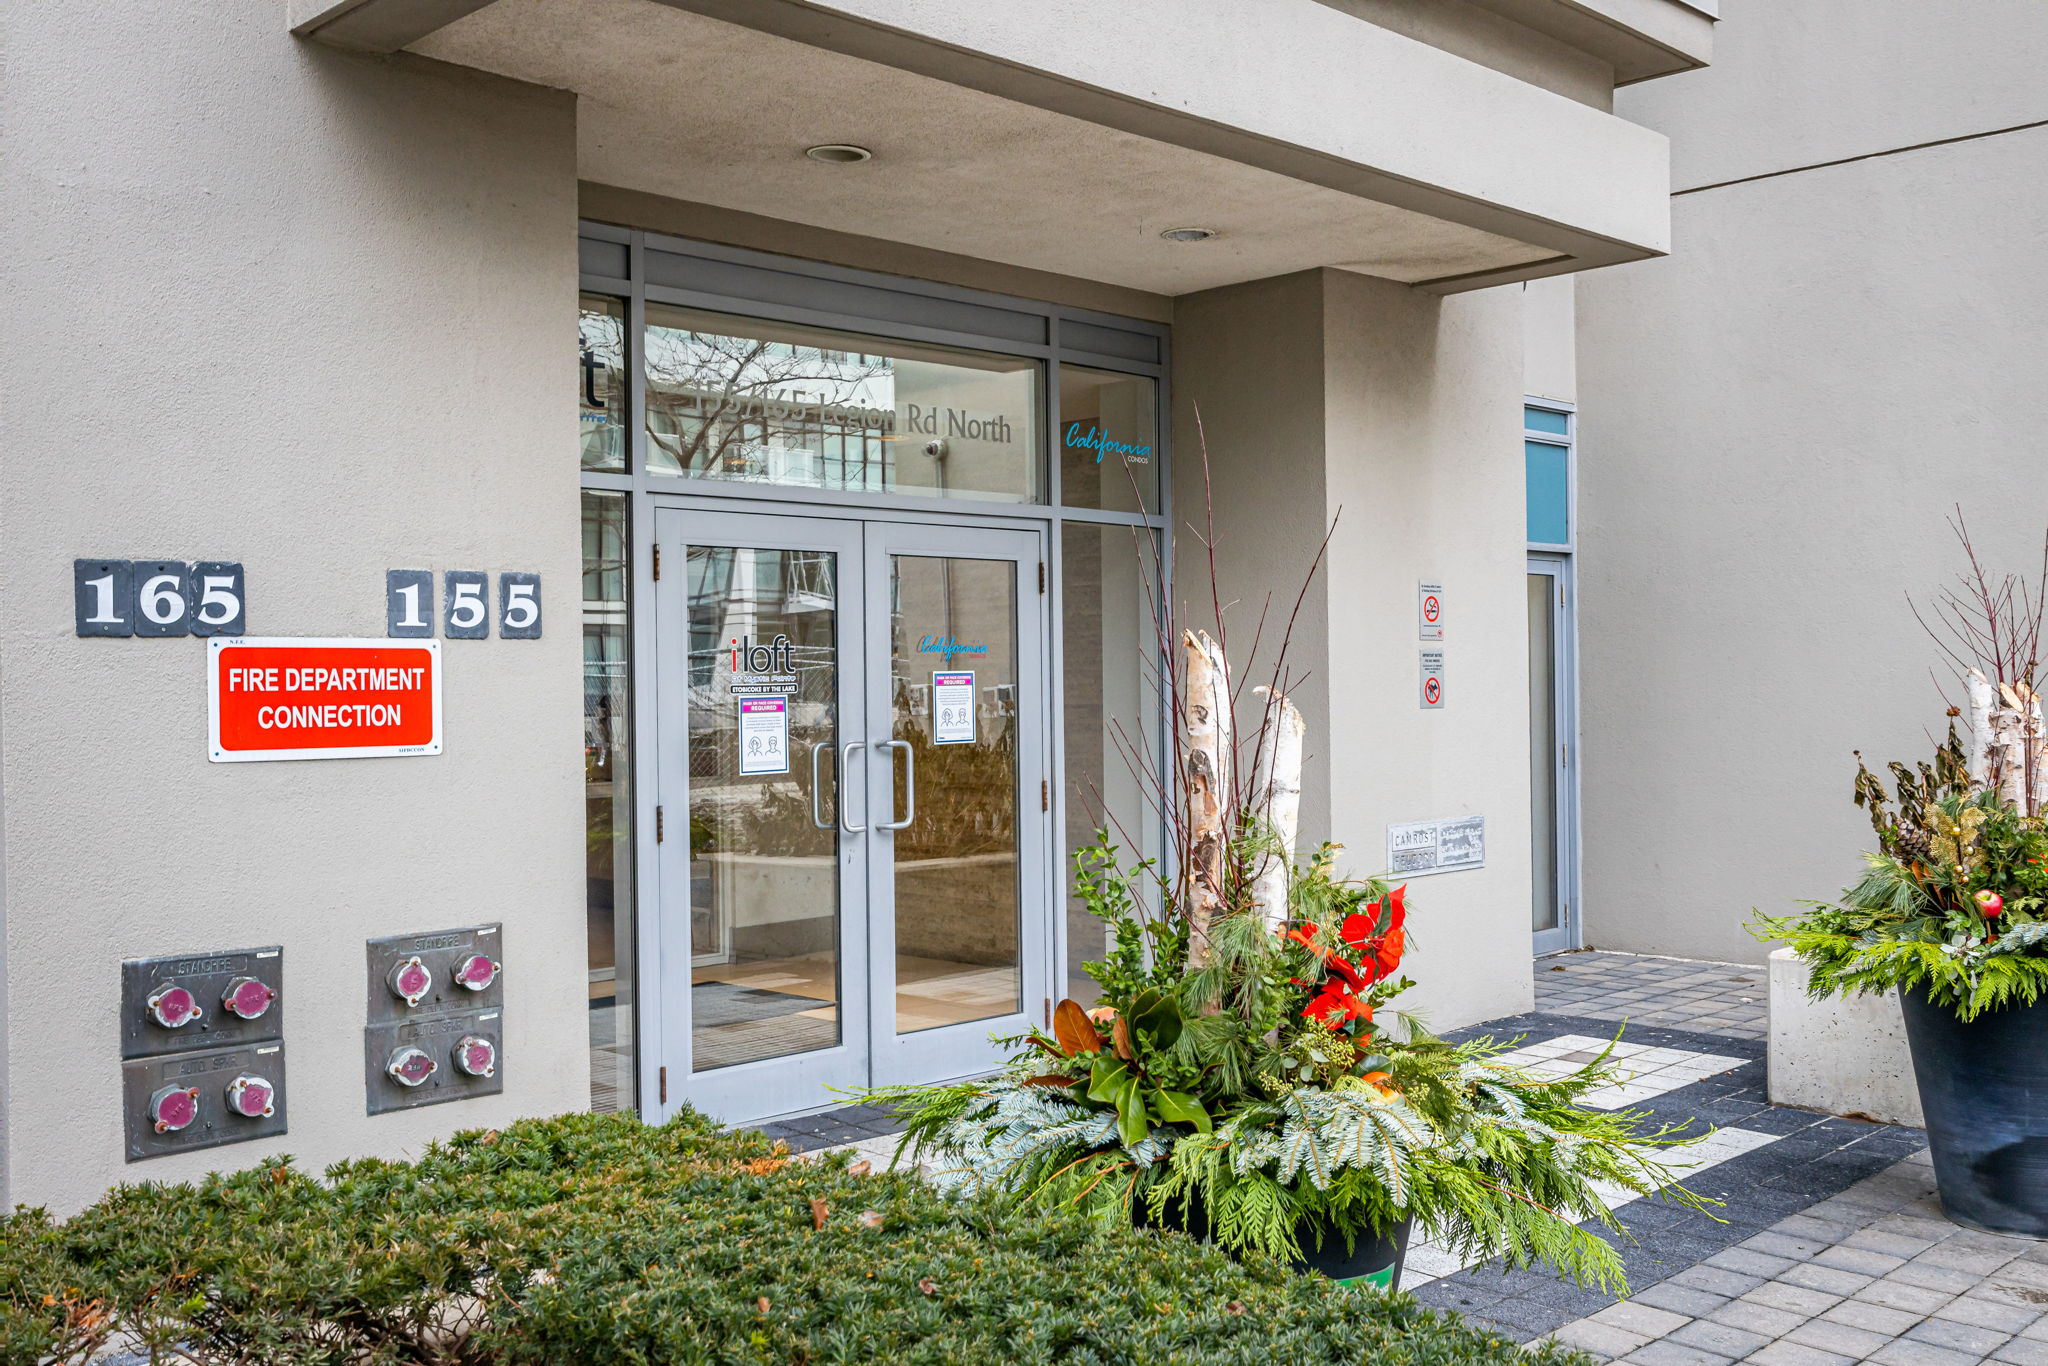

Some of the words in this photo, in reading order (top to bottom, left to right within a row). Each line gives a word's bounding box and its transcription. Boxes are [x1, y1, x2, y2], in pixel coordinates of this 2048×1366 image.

[819, 392, 896, 431] Legion
[908, 403, 937, 435] Rd
[947, 407, 1011, 443] North
[1066, 422, 1151, 464] California
[1127, 455, 1148, 465] CONDOS
[84, 574, 241, 625] 165
[396, 583, 538, 628] 155
[731, 634, 796, 673] iloft
[921, 635, 988, 661] California
[229, 667, 279, 692] FIRE
[285, 667, 425, 692] DEPARTMENT
[257, 704, 401, 729] CONNECTION
[1395, 832, 1434, 847] CAMROST
